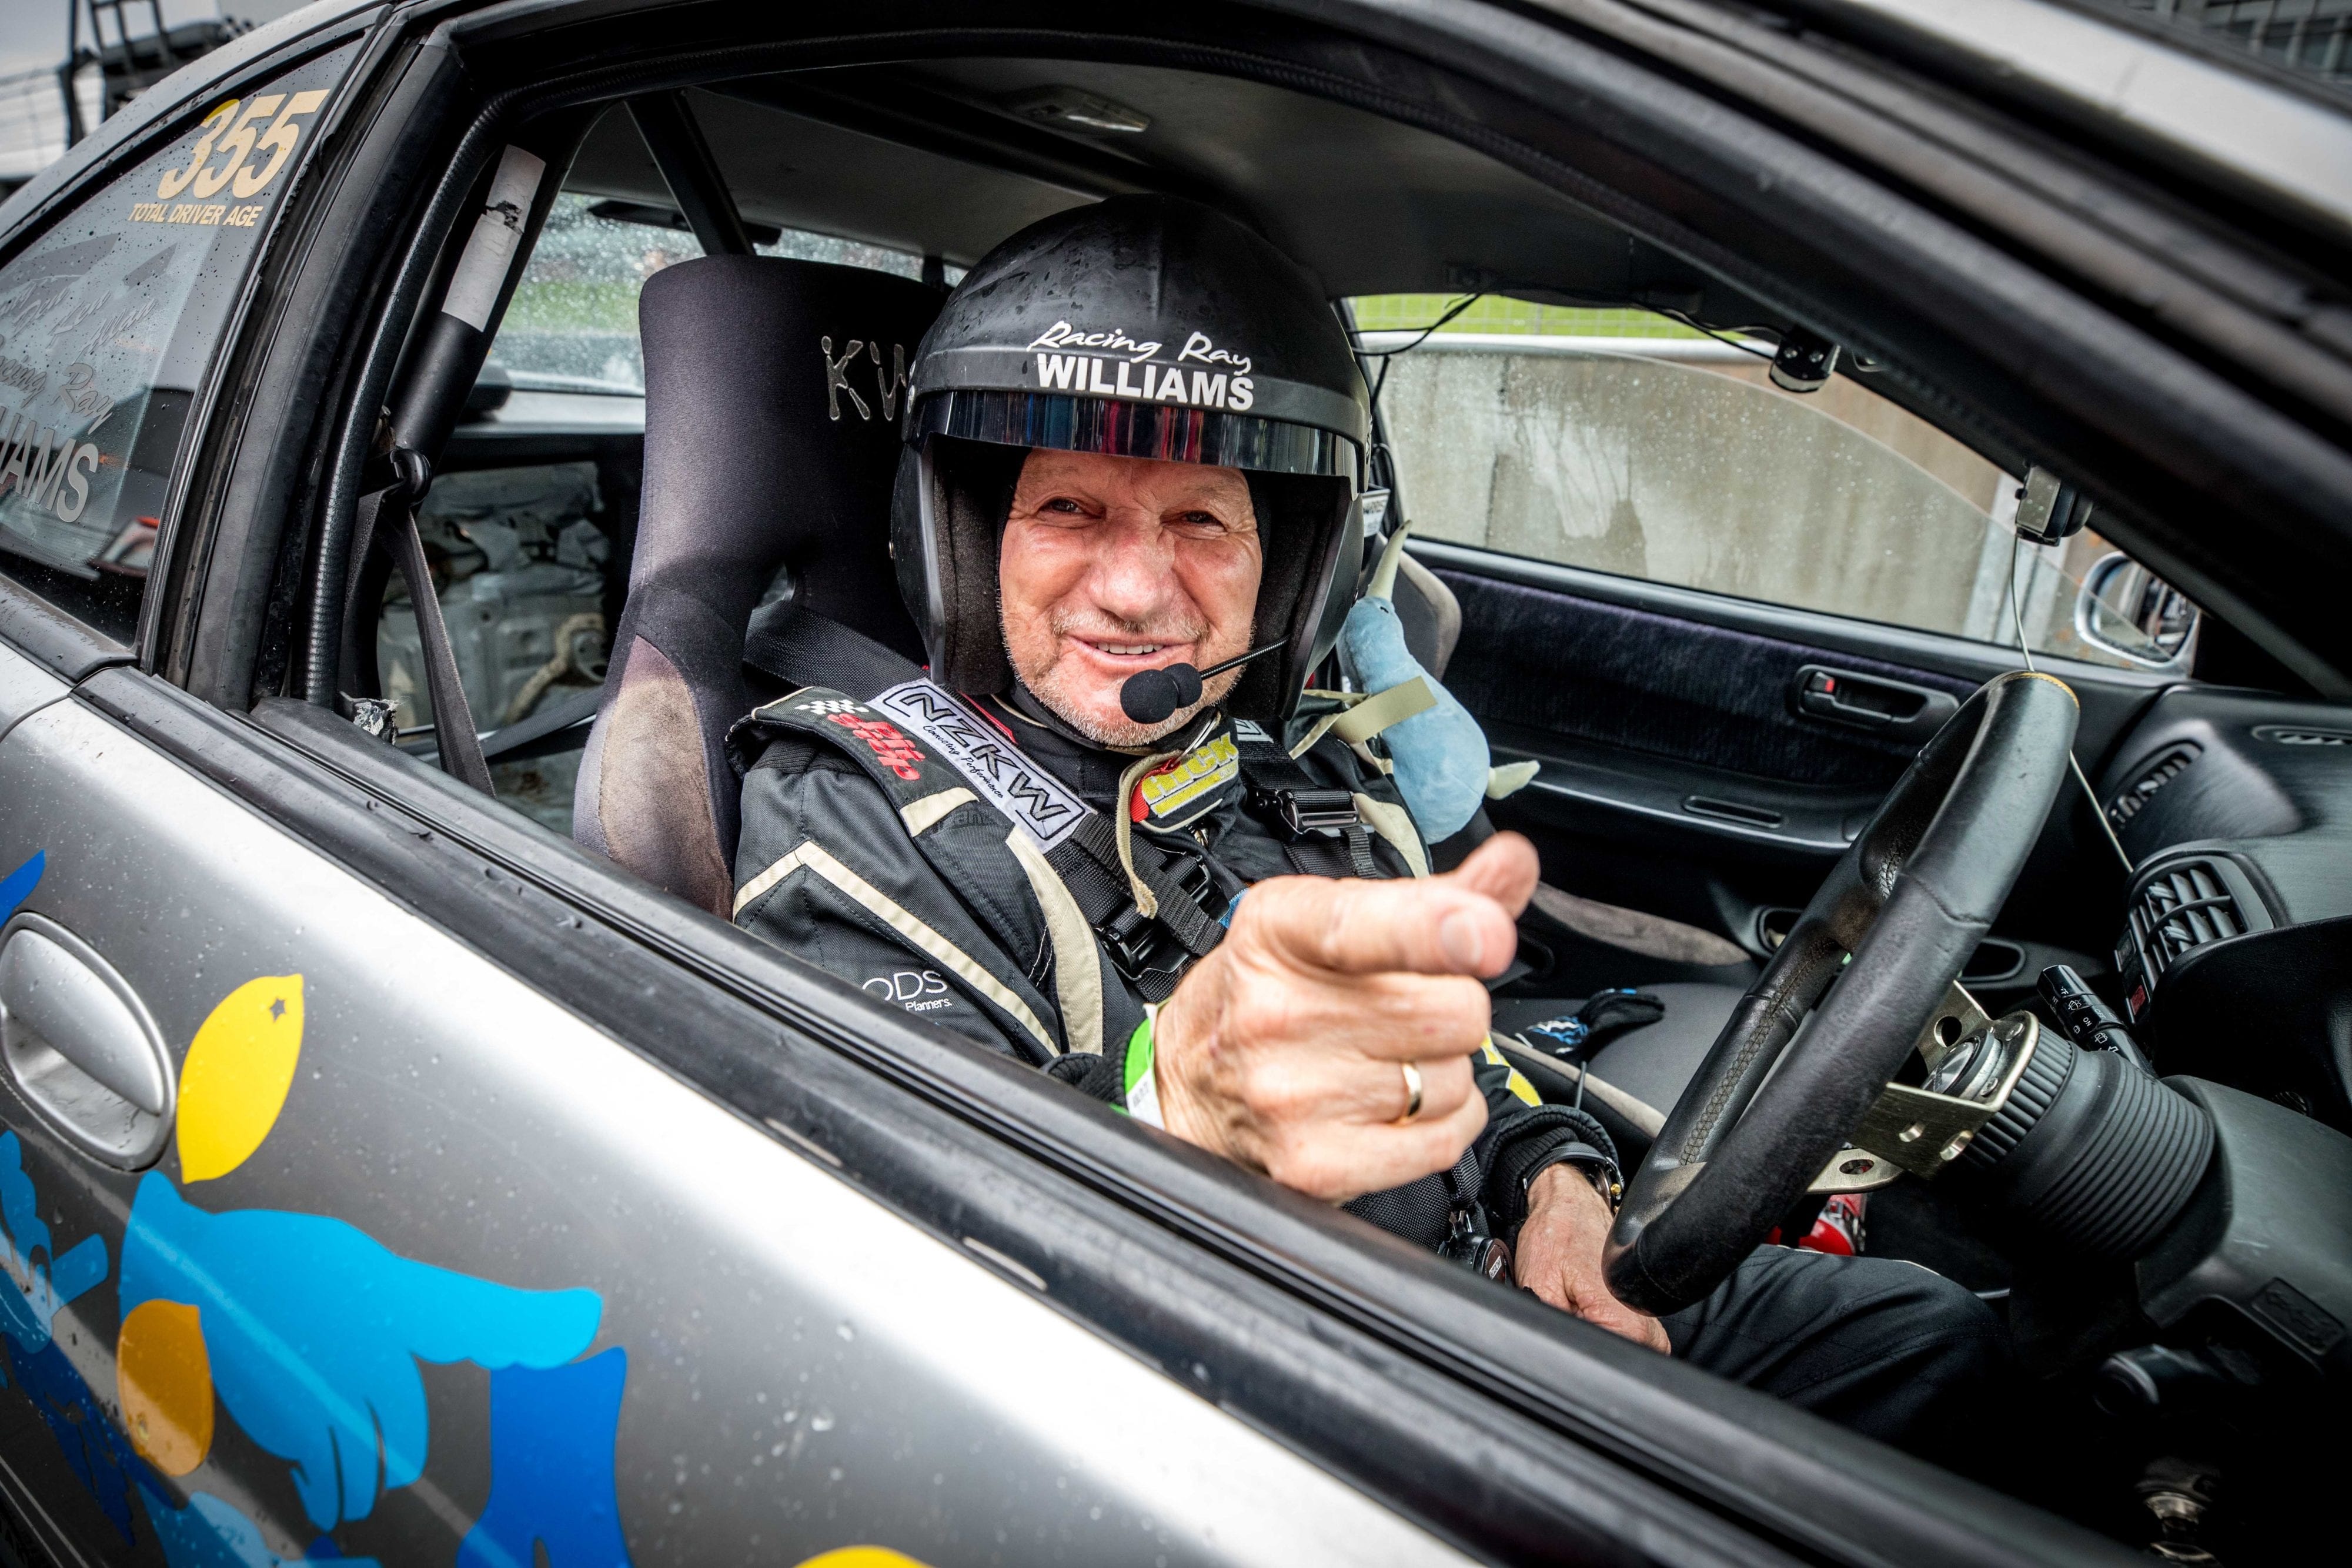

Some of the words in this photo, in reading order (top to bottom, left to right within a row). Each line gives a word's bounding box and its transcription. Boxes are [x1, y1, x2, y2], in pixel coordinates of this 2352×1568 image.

[157, 89, 330, 200] 355
[128, 203, 170, 223] TOTAL
[167, 204, 226, 225] DRIVER
[223, 205, 264, 227] AGE
[1026, 320, 1162, 364] Racing
[1178, 331, 1252, 376] Ray
[50, 362, 116, 436] Ray
[1037, 353, 1254, 411] WILLIAMS
[0, 406, 99, 523] IAMS
[898, 692, 1071, 823] NZKW
[923, 726, 960, 755] Connecting
[960, 757, 1004, 798] Performance
[862, 970, 948, 1001] ODS
[2060, 986, 2069, 994] FF
[2083, 1017, 2092, 1027] ON
